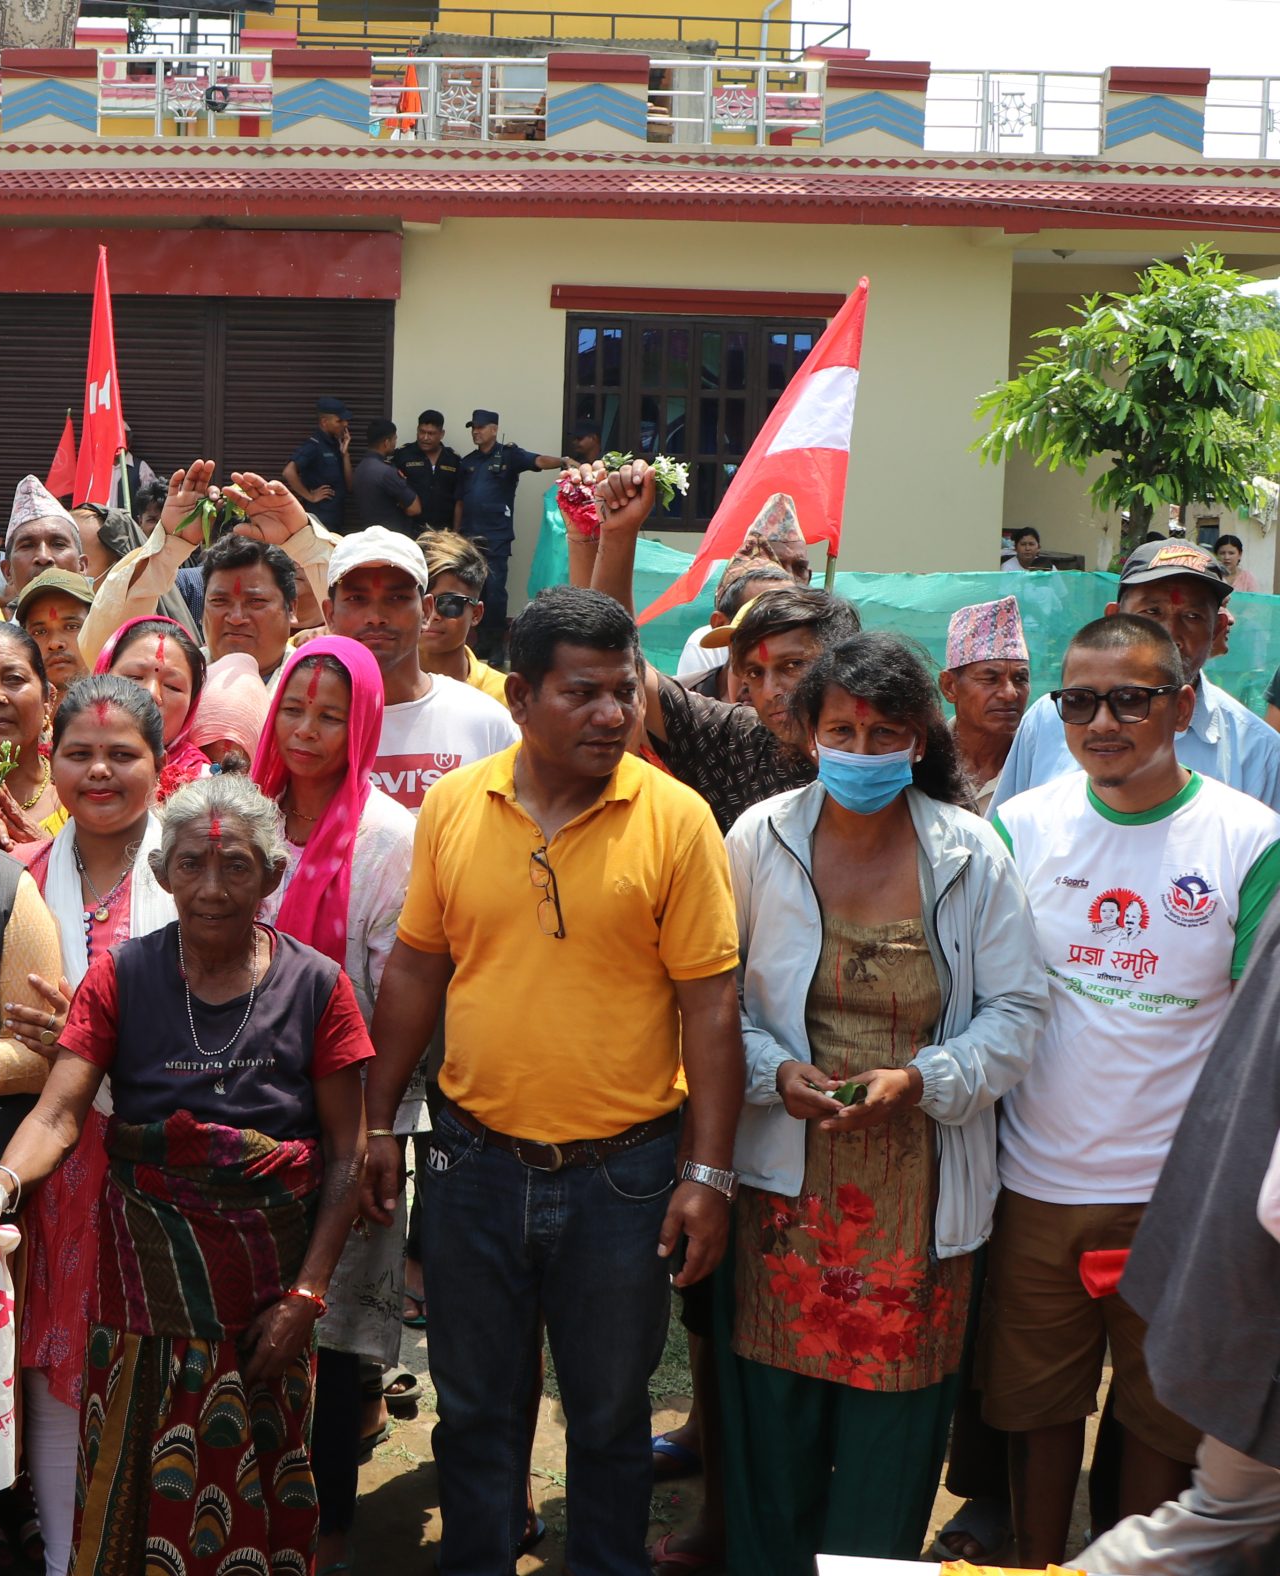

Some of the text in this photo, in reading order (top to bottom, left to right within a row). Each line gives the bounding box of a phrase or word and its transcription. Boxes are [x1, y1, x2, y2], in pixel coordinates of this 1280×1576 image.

[367, 768, 442, 794] evi's
[1066, 944, 1160, 980] प्रज्ञा स्मृति
[1128, 1001, 1163, 1014] २०७८
